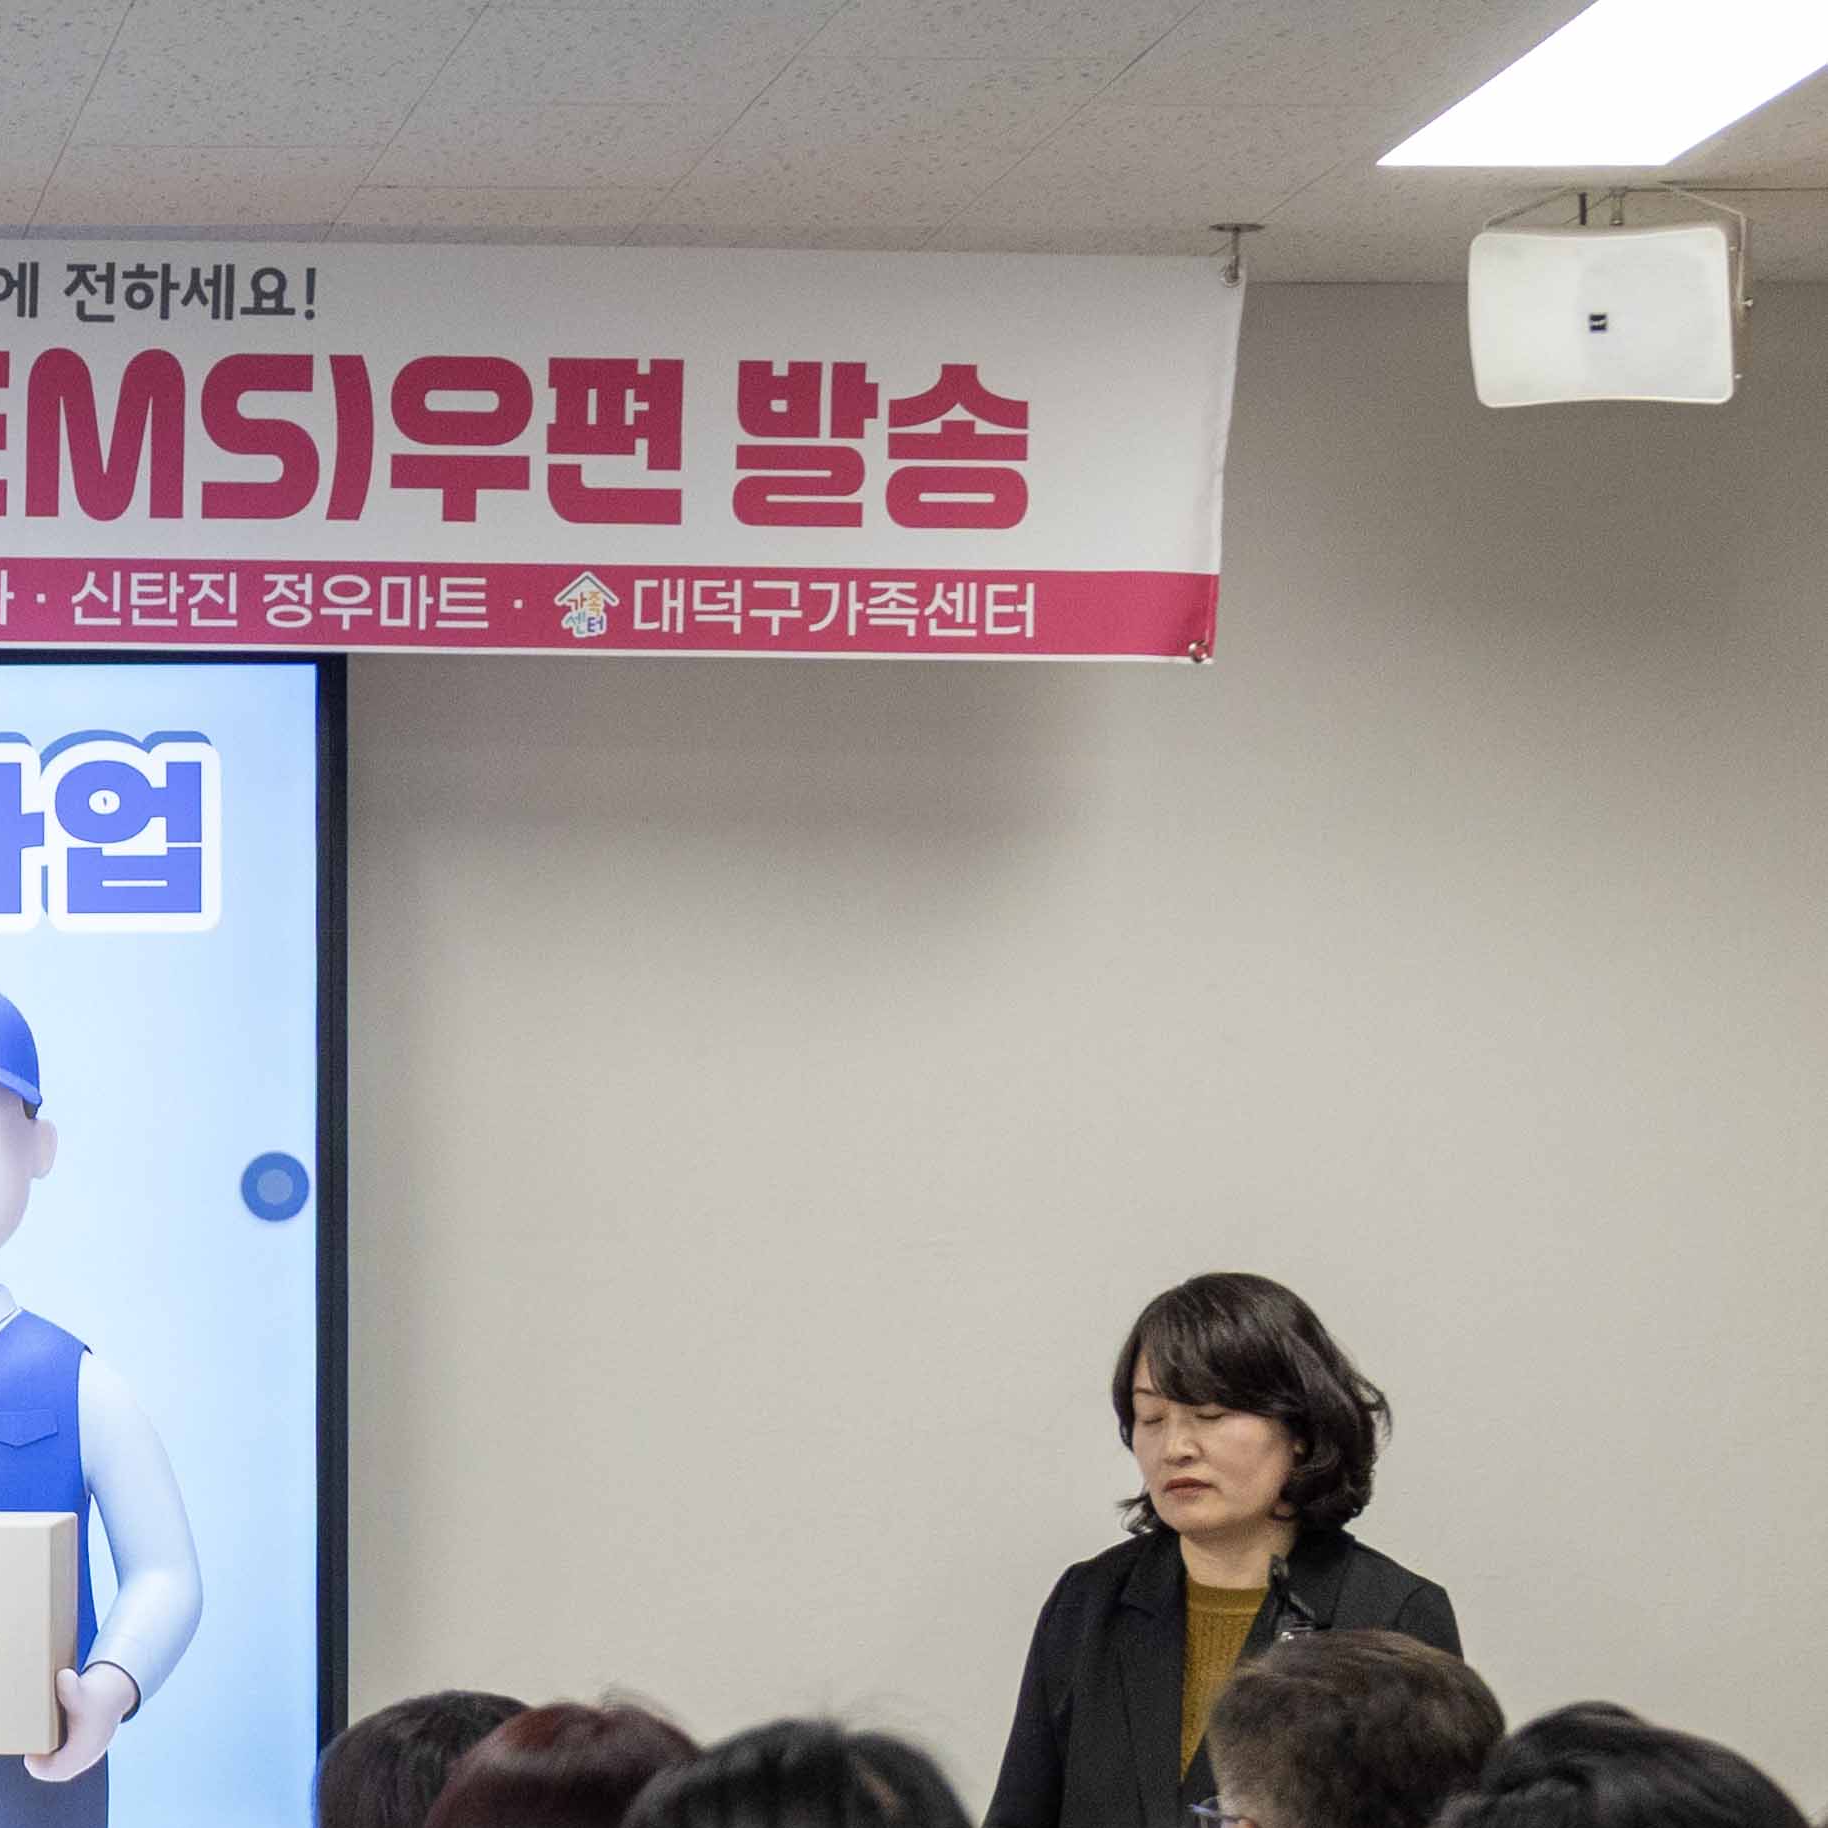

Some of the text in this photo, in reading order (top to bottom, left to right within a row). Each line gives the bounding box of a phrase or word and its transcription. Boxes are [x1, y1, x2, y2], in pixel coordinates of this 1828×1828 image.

[63, 261, 317, 323] 전하세요!
[732, 360, 1030, 530] 발송
[70, 570, 240, 629] 신탄진
[263, 571, 489, 631] 정우마트
[633, 577, 1037, 639] 대덕구가족센터
